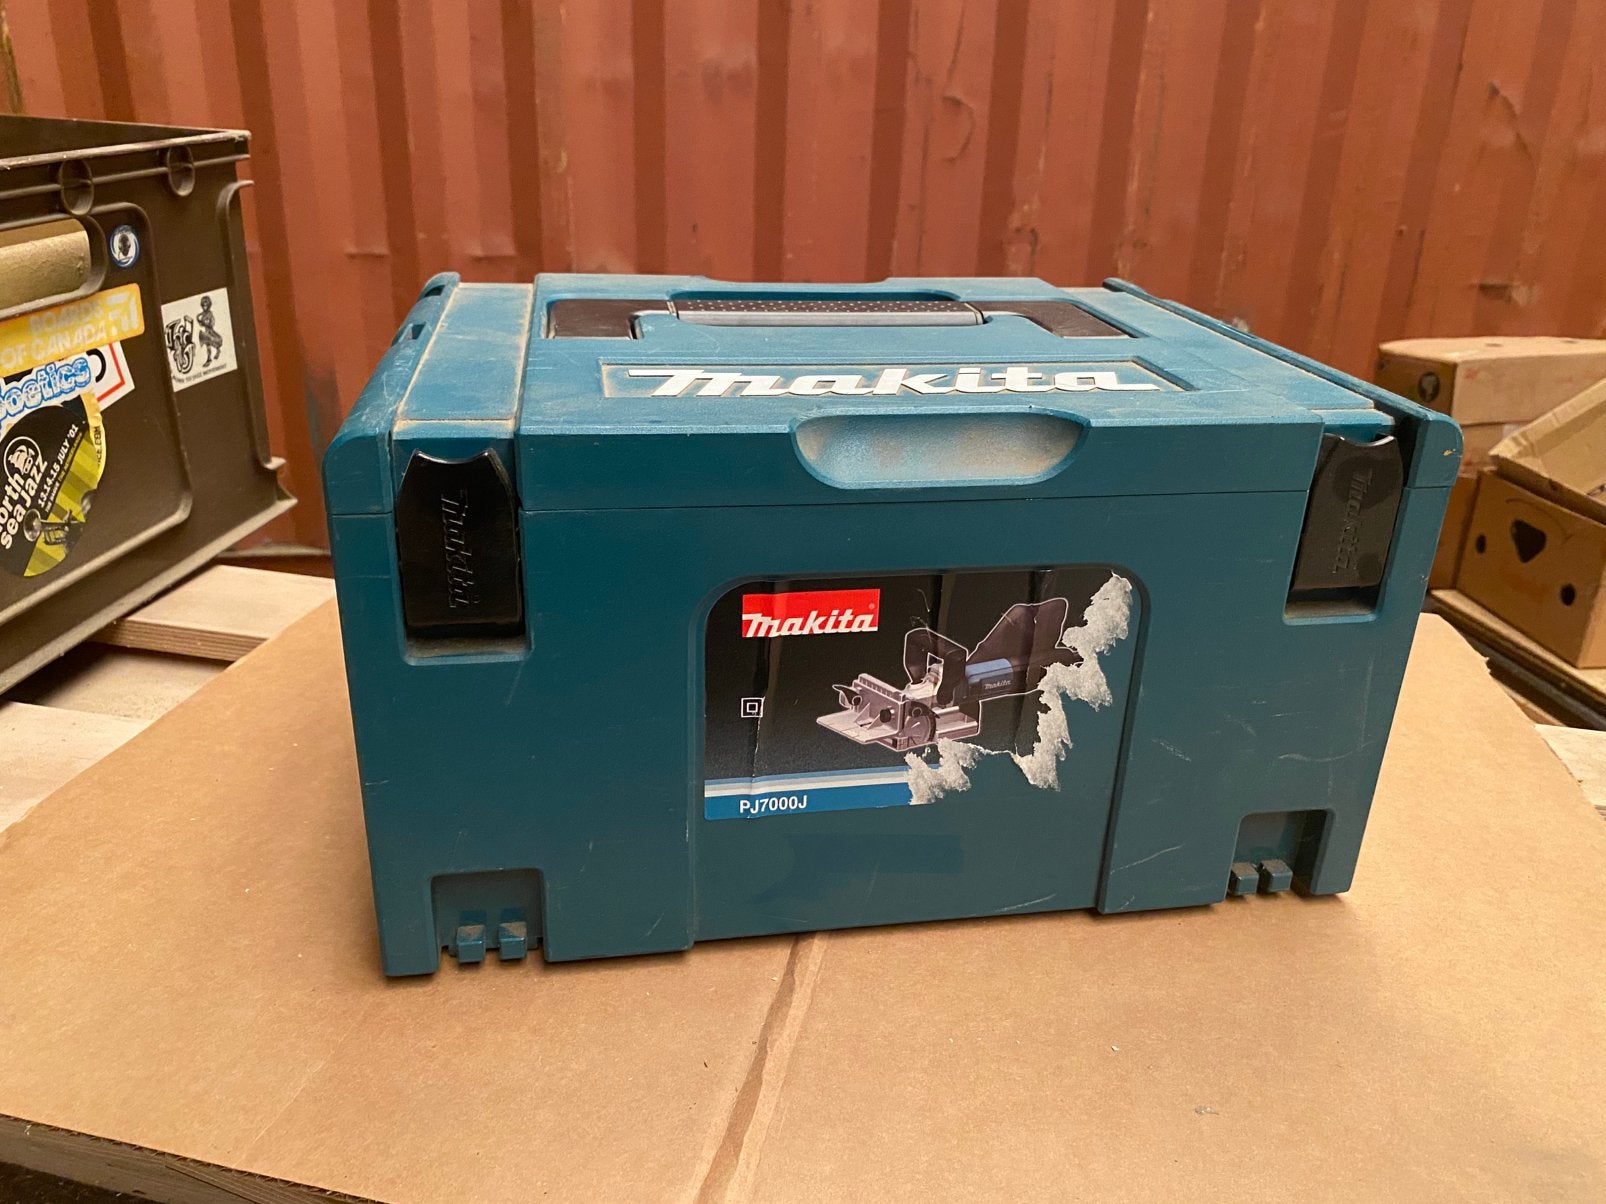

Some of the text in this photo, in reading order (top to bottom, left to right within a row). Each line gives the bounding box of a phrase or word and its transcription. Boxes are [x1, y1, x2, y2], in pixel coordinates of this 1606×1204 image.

[1, 321, 107, 369] OF CANADA
[58, 439, 70, 465] JULY
[0, 460, 25, 533] orth
[0, 504, 26, 550] sea
[739, 794, 808, 815] PJ7000J
